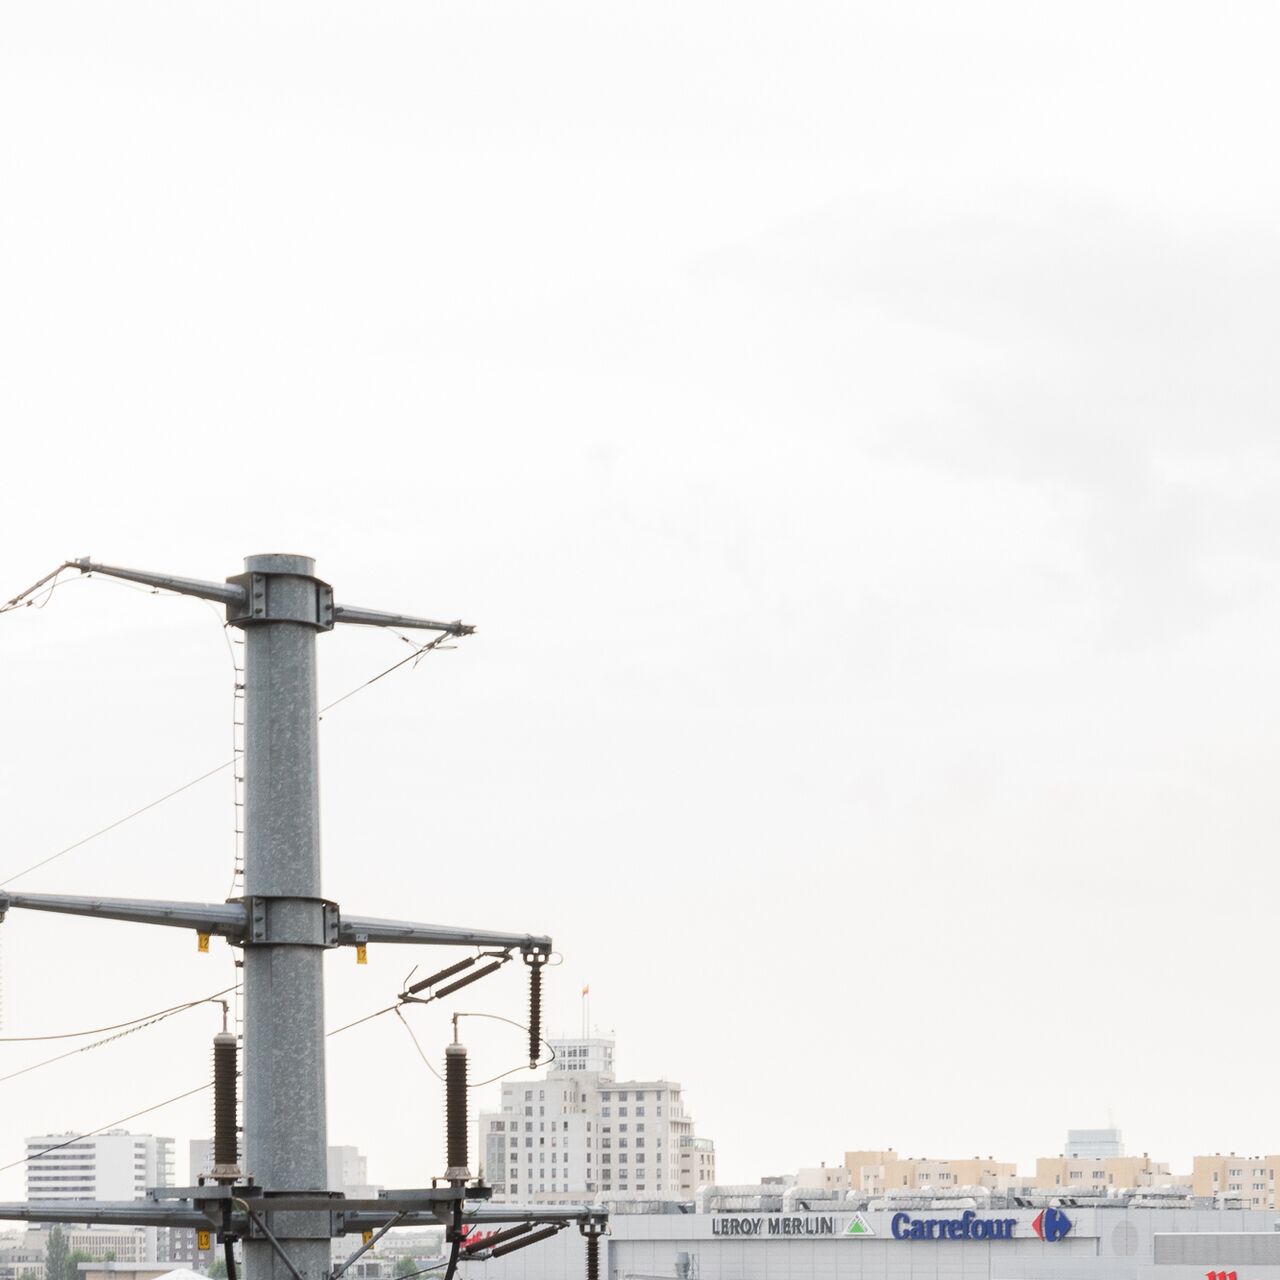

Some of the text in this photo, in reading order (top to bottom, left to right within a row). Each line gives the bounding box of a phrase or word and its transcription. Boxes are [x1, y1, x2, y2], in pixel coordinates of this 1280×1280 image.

[712, 1218, 761, 1235] LEROY
[768, 1217, 834, 1235] MERLIN
[891, 1210, 1017, 1240] Carrefour
